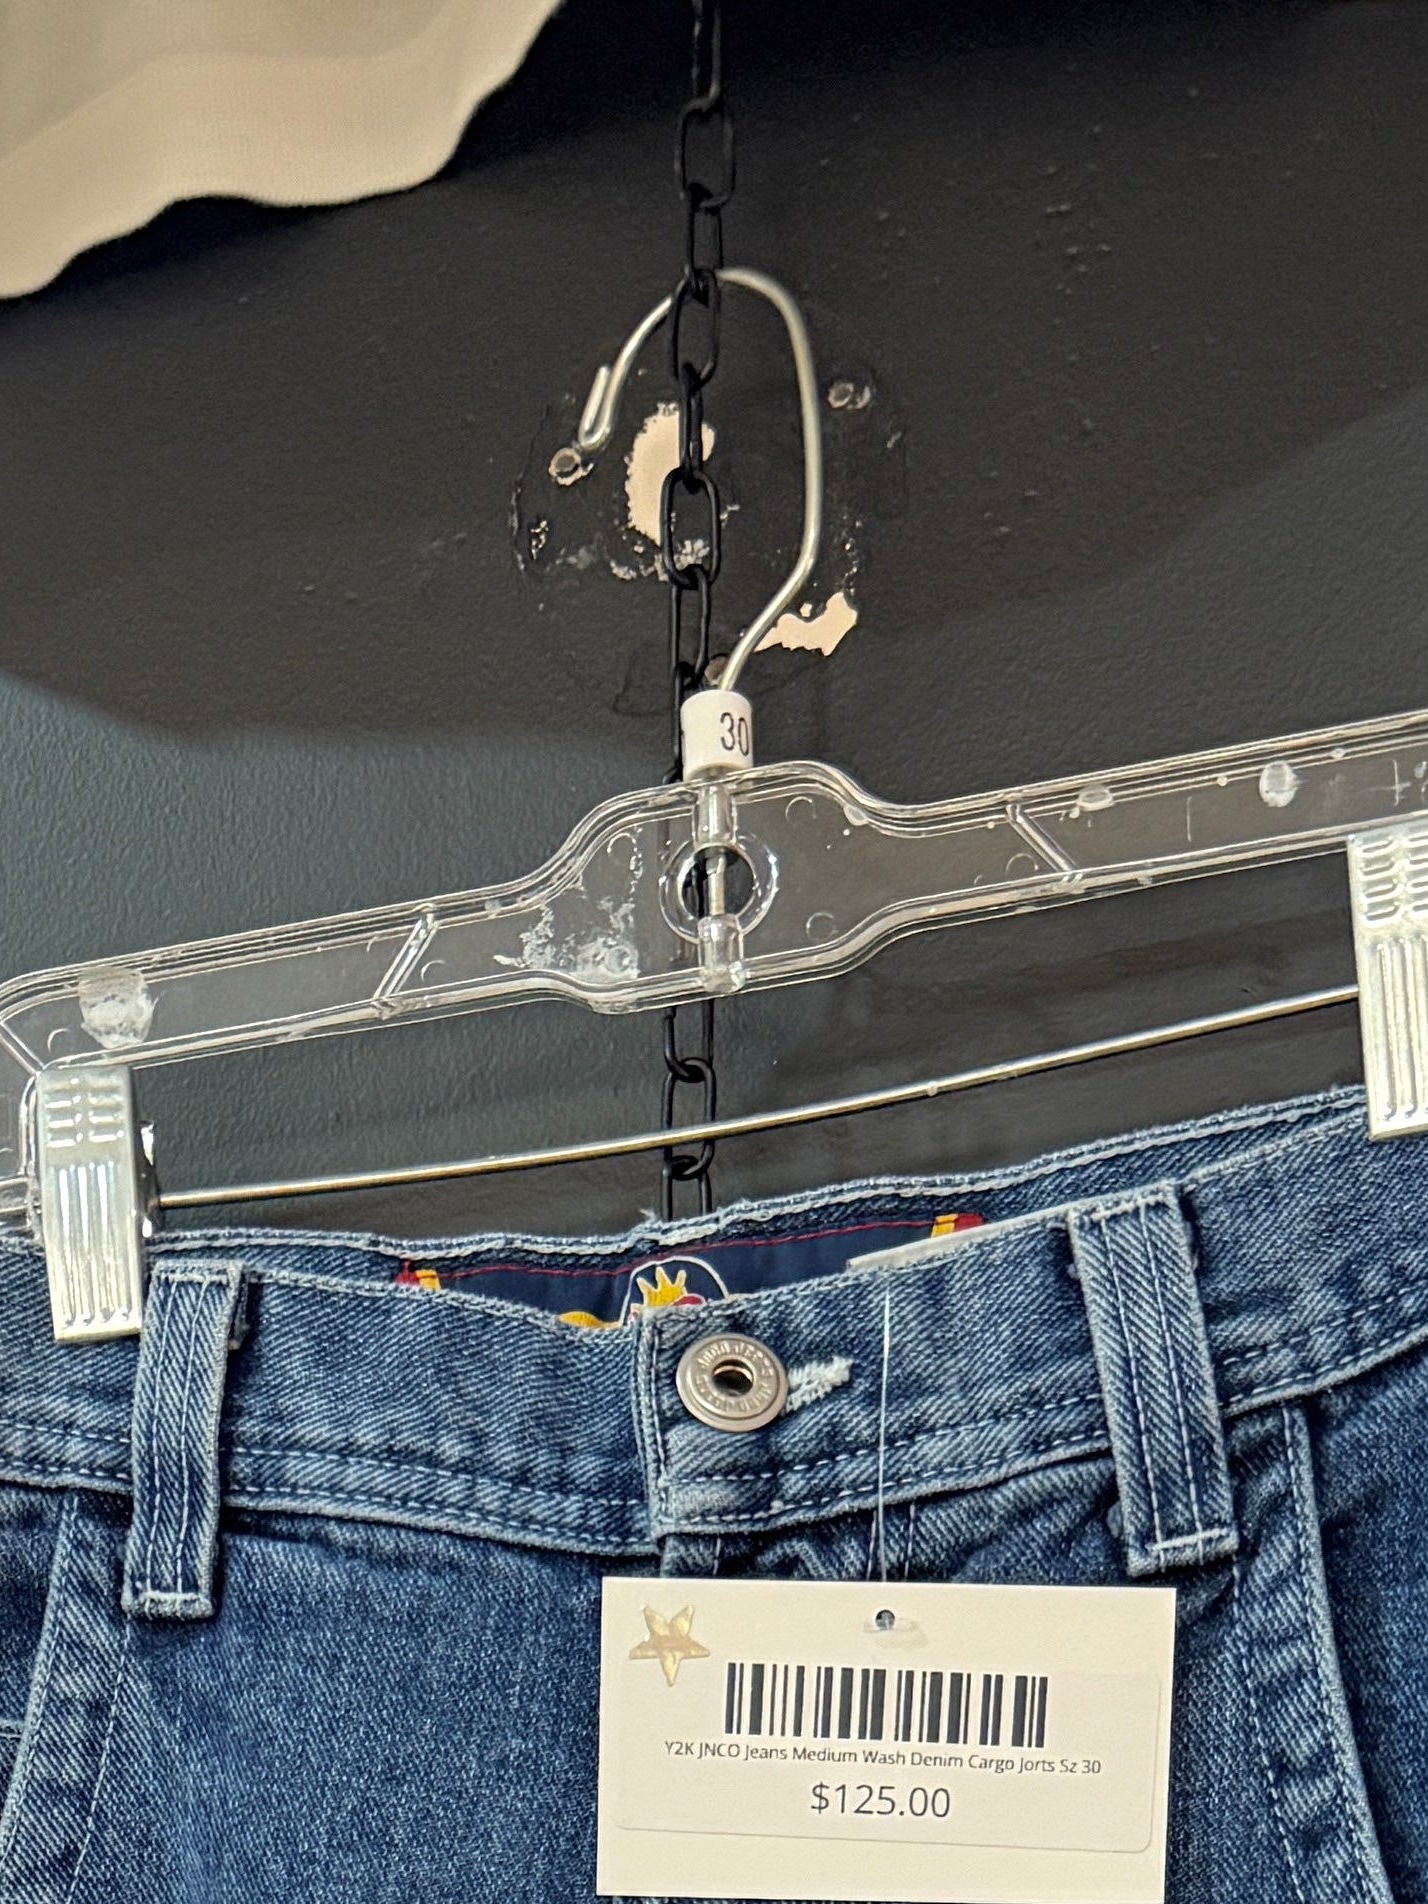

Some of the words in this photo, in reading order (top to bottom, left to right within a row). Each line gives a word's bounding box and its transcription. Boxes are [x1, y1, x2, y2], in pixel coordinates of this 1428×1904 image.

[720, 712, 750, 756] 30
[665, 1741, 694, 1756] Y2K
[697, 1743, 740, 1759] JNCO
[744, 1745, 788, 1760] Jeans
[792, 1747, 858, 1763] Medium
[863, 1749, 906, 1765] Wash
[910, 1752, 963, 1768] Denim
[968, 1755, 1014, 1774] Cargo
[1018, 1757, 1055, 1773] Jorts
[1059, 1759, 1077, 1774] Sz
[1081, 1760, 1102, 1774] 30
[811, 1781, 951, 1818] $125.00
